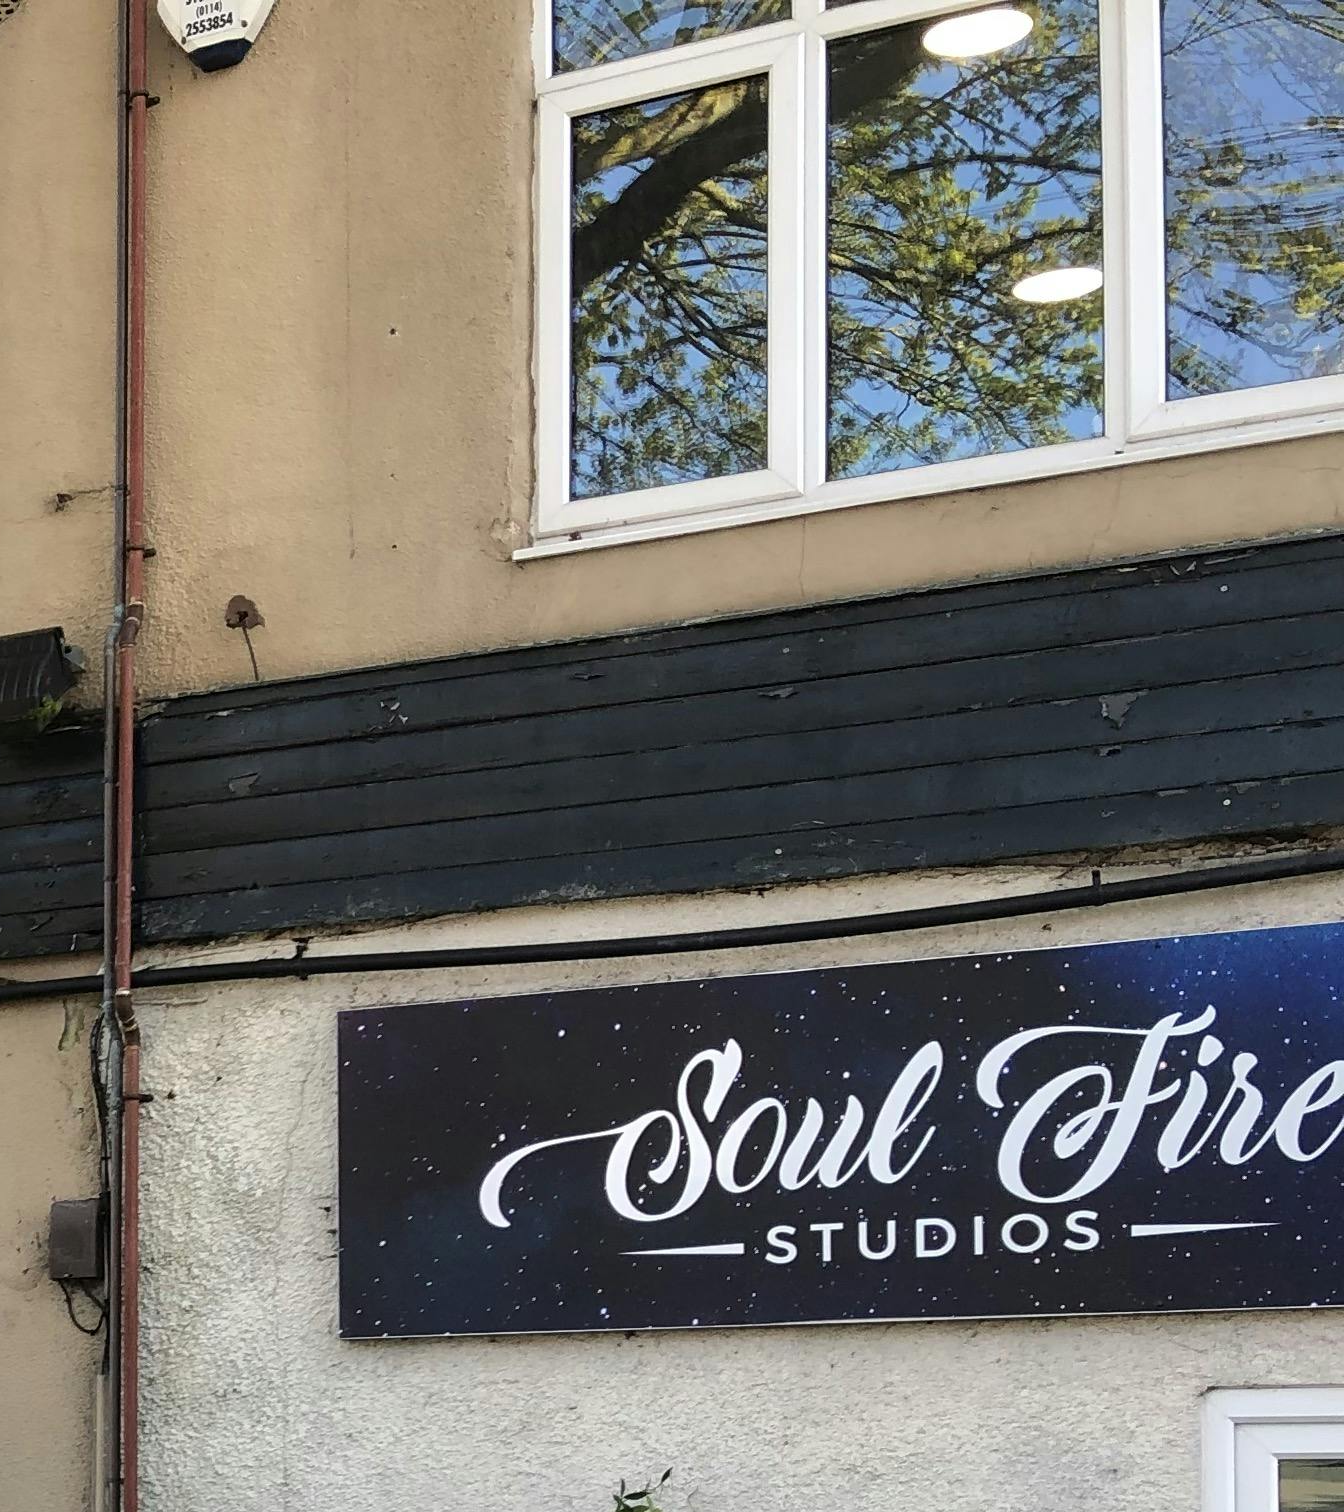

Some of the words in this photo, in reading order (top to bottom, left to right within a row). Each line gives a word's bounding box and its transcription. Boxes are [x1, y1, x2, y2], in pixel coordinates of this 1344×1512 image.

[185, 12, 234, 37] 2553854
[196, 0, 222, 18] (0114)
[478, 1038, 944, 1228] Soul
[976, 1004, 1344, 1203] Fire
[764, 1210, 1102, 1265] STUDIOS
